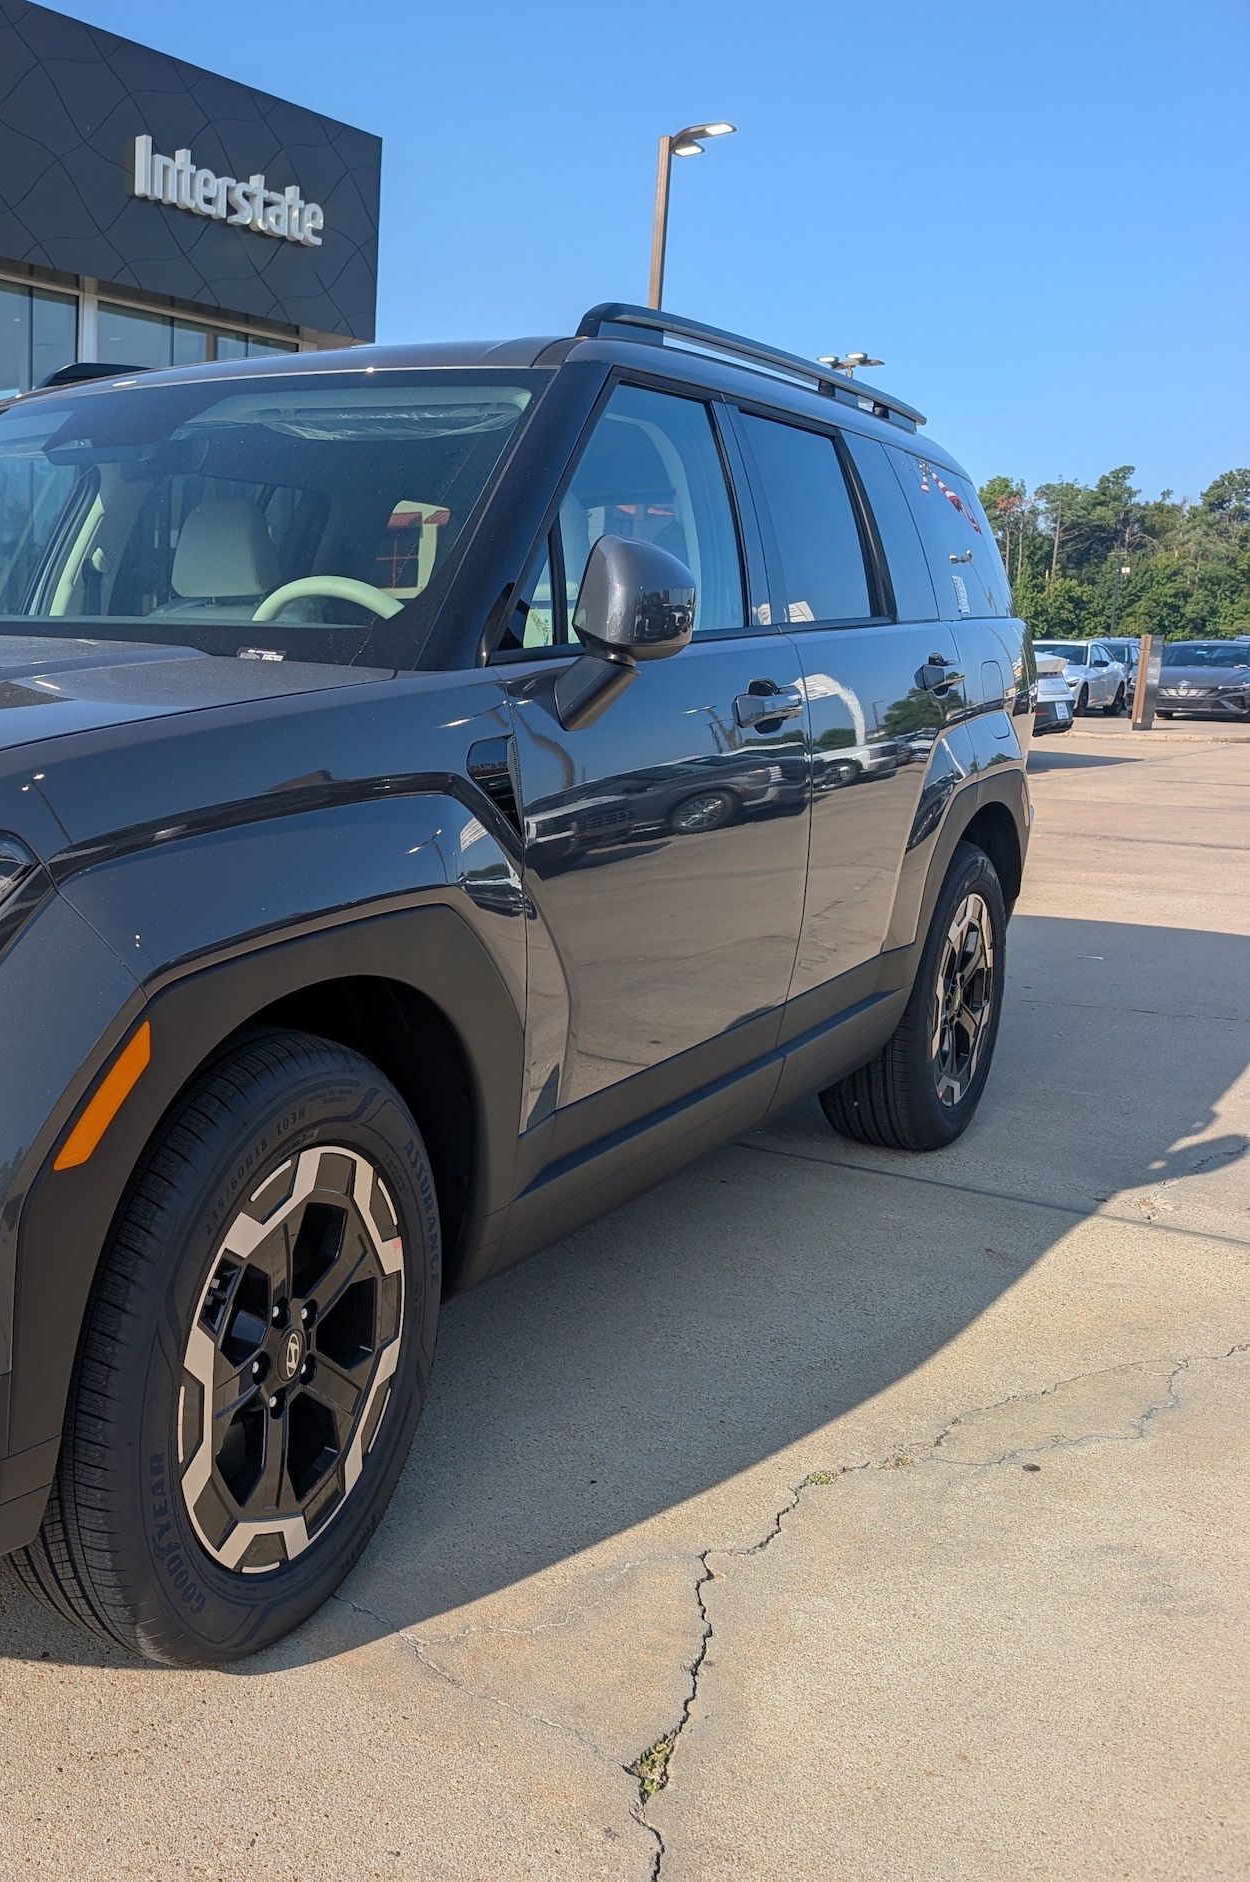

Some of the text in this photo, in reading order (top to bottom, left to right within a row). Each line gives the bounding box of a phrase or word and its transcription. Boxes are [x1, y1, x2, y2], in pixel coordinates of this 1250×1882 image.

[134, 134, 324, 247] Interstate
[205, 1136, 268, 1237] 235/60R18
[276, 1106, 306, 1137] 103H
[402, 1138, 441, 1288] ASSURANCE
[150, 1451, 206, 1615] GOODYEAR
